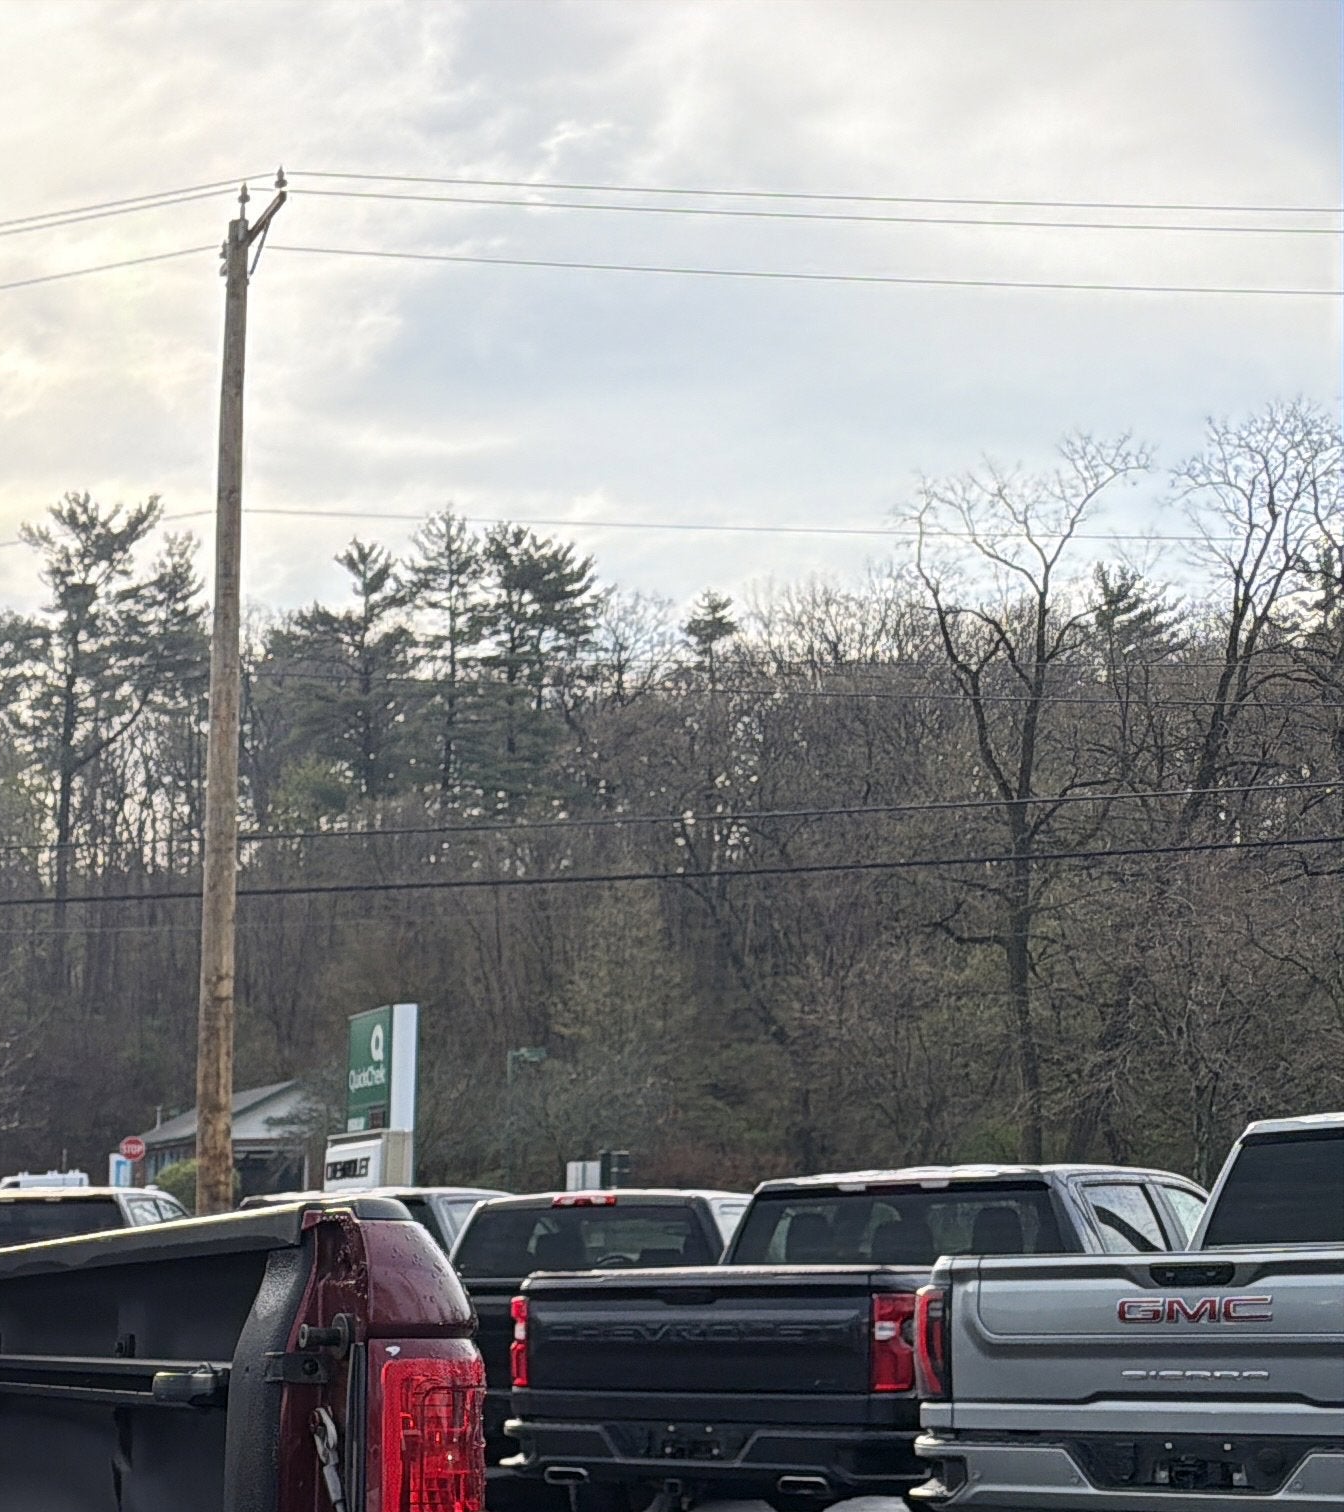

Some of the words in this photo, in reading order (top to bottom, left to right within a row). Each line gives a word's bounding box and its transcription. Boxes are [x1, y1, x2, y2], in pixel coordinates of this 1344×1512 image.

[349, 1063, 387, 1093] QuickChek
[121, 1143, 144, 1155] STOP
[1117, 1294, 1273, 1323] GMC
[1121, 1370, 1270, 1381] SIERRA
